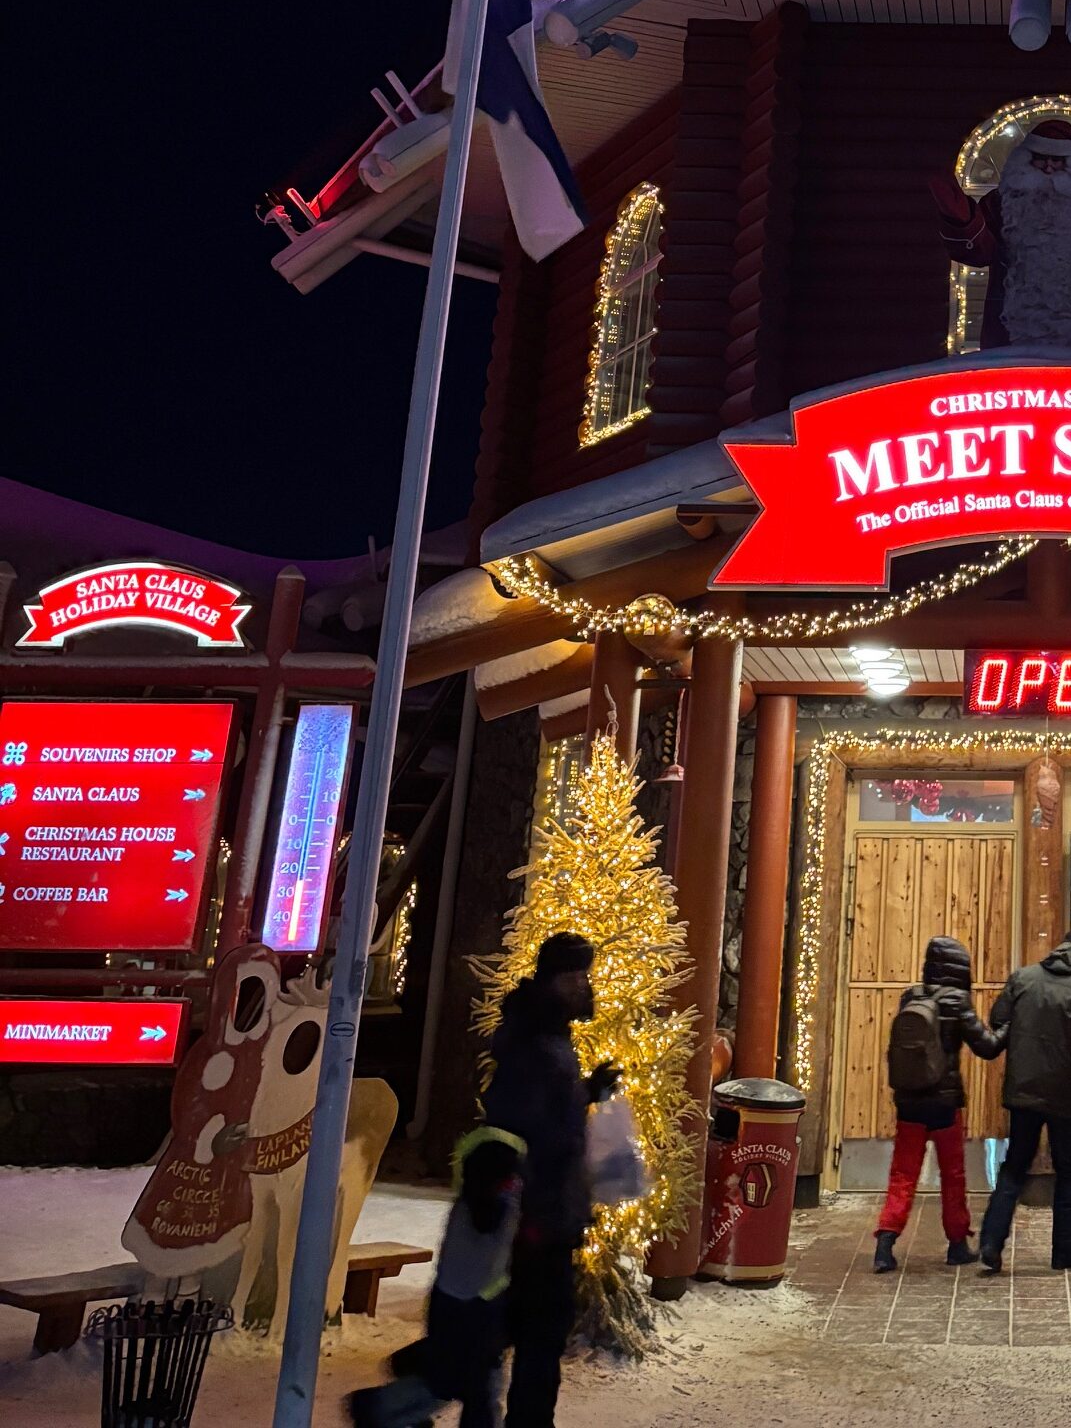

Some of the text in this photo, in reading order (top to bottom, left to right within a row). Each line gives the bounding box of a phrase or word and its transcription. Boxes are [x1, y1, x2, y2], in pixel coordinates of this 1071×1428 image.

[828, 424, 1034, 502] MEET
[856, 513, 892, 533] The
[894, 496, 960, 523] Official
[965, 493, 1011, 512] Santa
[1015, 490, 1063, 508] Claus
[76, 574, 206, 598] SANTA CLAUS
[50, 592, 221, 627] HOLIDAY VILLAGE
[40, 747, 177, 763] SOUVENIRS SHOP
[32, 787, 140, 802] SANTA CLAUS
[322, 791, 339, 803] 10
[289, 814, 335, 826] 0 0
[24, 827, 176, 842] CHRISTMAS HOUSE
[20, 846, 125, 862] RESTAURANT
[280, 863, 298, 874] 20
[13, 887, 109, 903] COFFEE BAR
[277, 887, 295, 898] 30
[273, 911, 290, 923] 40
[4, 1024, 112, 1041] MINIMARKET
[257, 1119, 312, 1155] LAPLAN
[255, 1138, 312, 1171] FINLAN
[731, 1143, 792, 1161] SANTA CLAUS
[167, 1160, 212, 1183] ARCTIC
